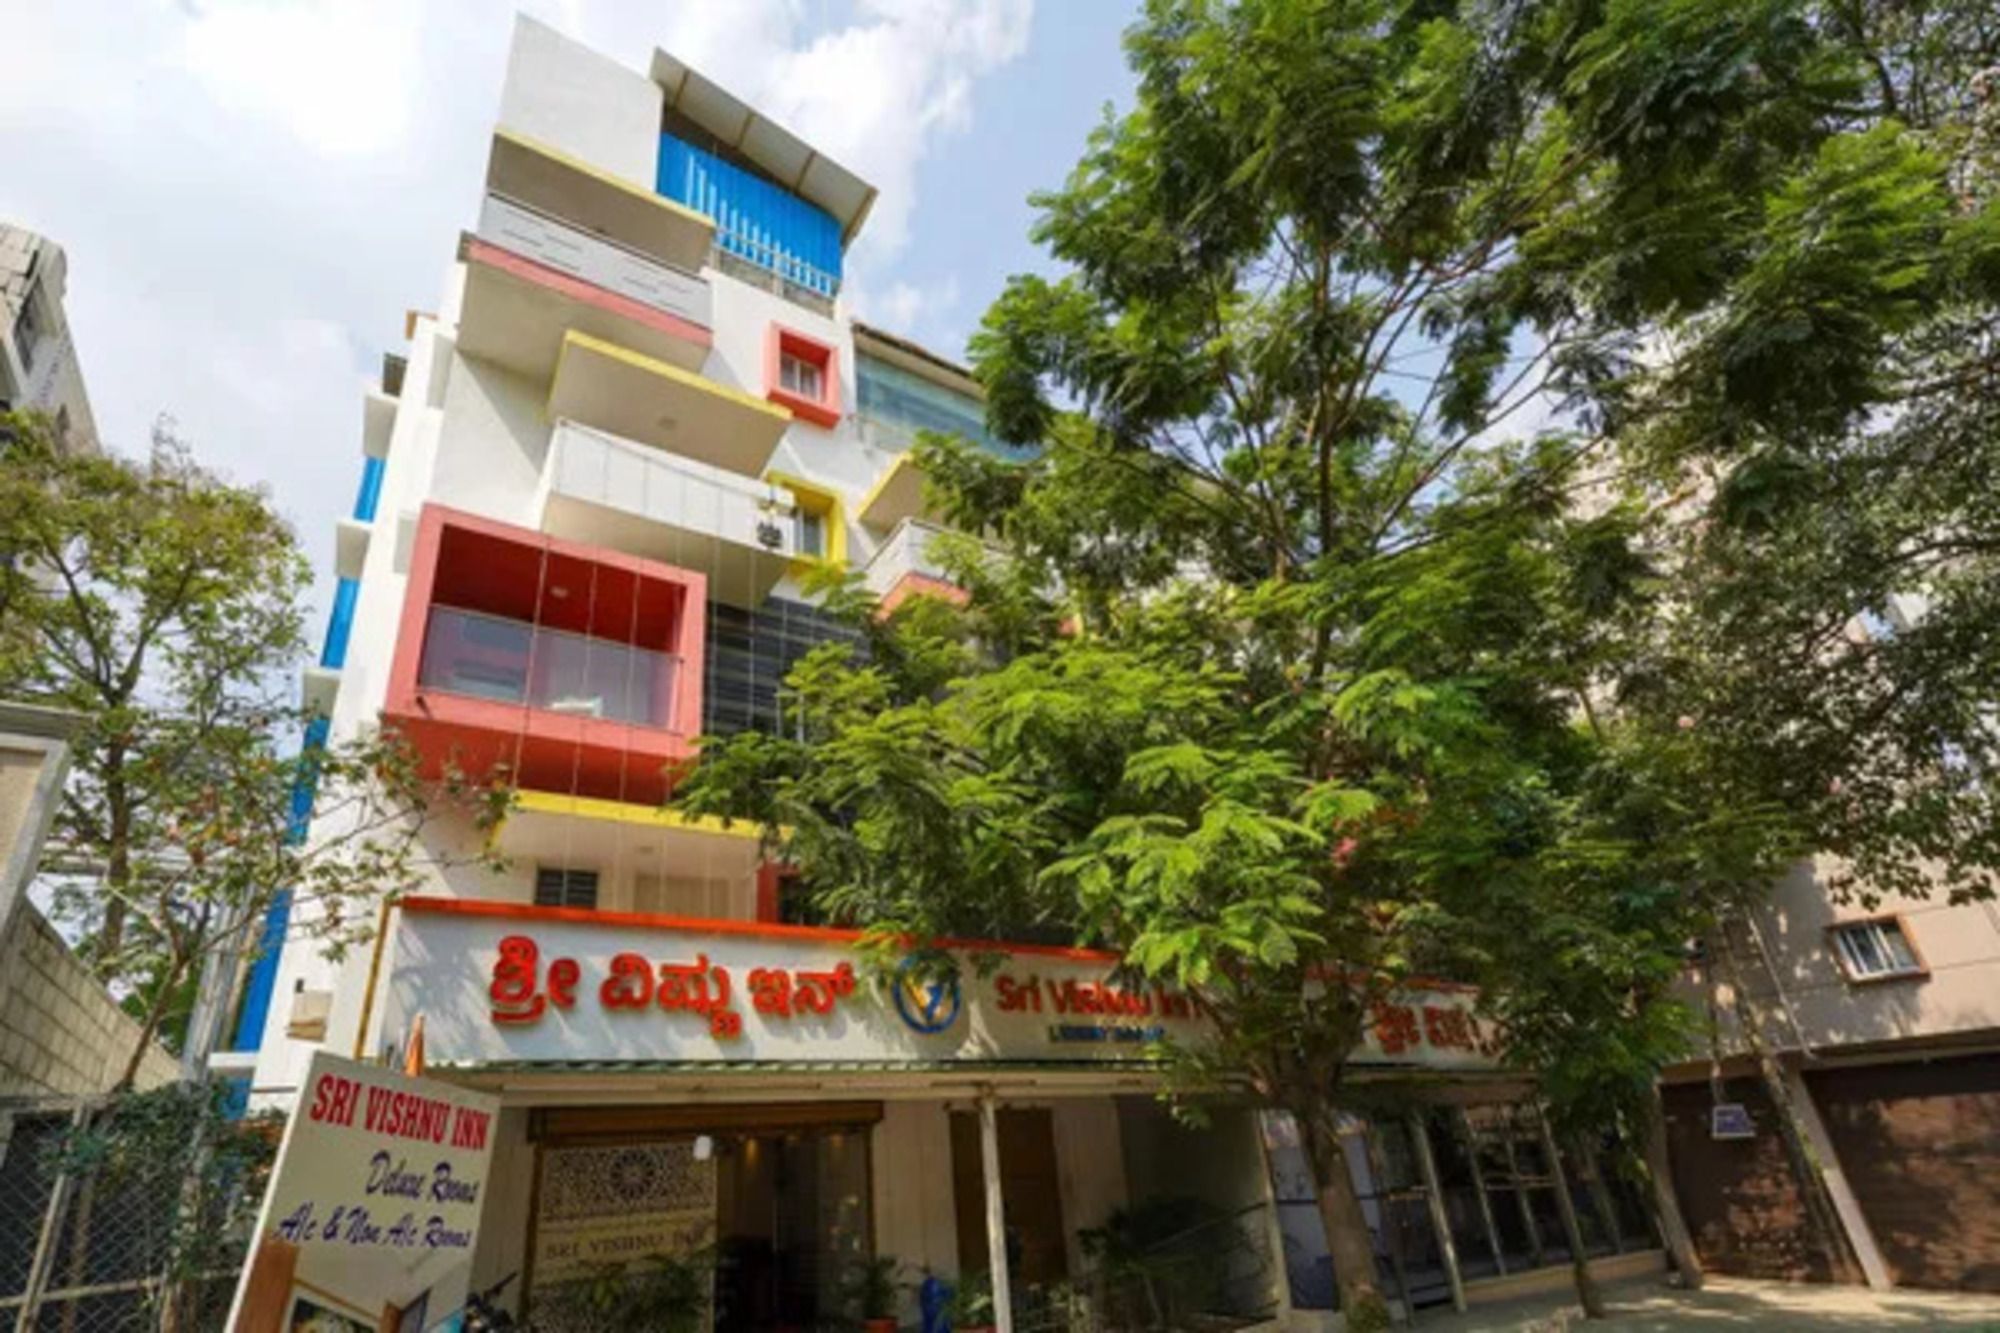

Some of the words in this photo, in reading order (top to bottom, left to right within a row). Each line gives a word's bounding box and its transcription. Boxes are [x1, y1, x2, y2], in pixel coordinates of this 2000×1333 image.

[489, 934, 581, 1026] ಶ್ರೀ
[600, 950, 743, 1040] ವಿಷ್ಣು
[308, 1072, 362, 1128] SRI
[362, 1084, 451, 1144] VISHNU
[450, 1104, 491, 1151] INN
